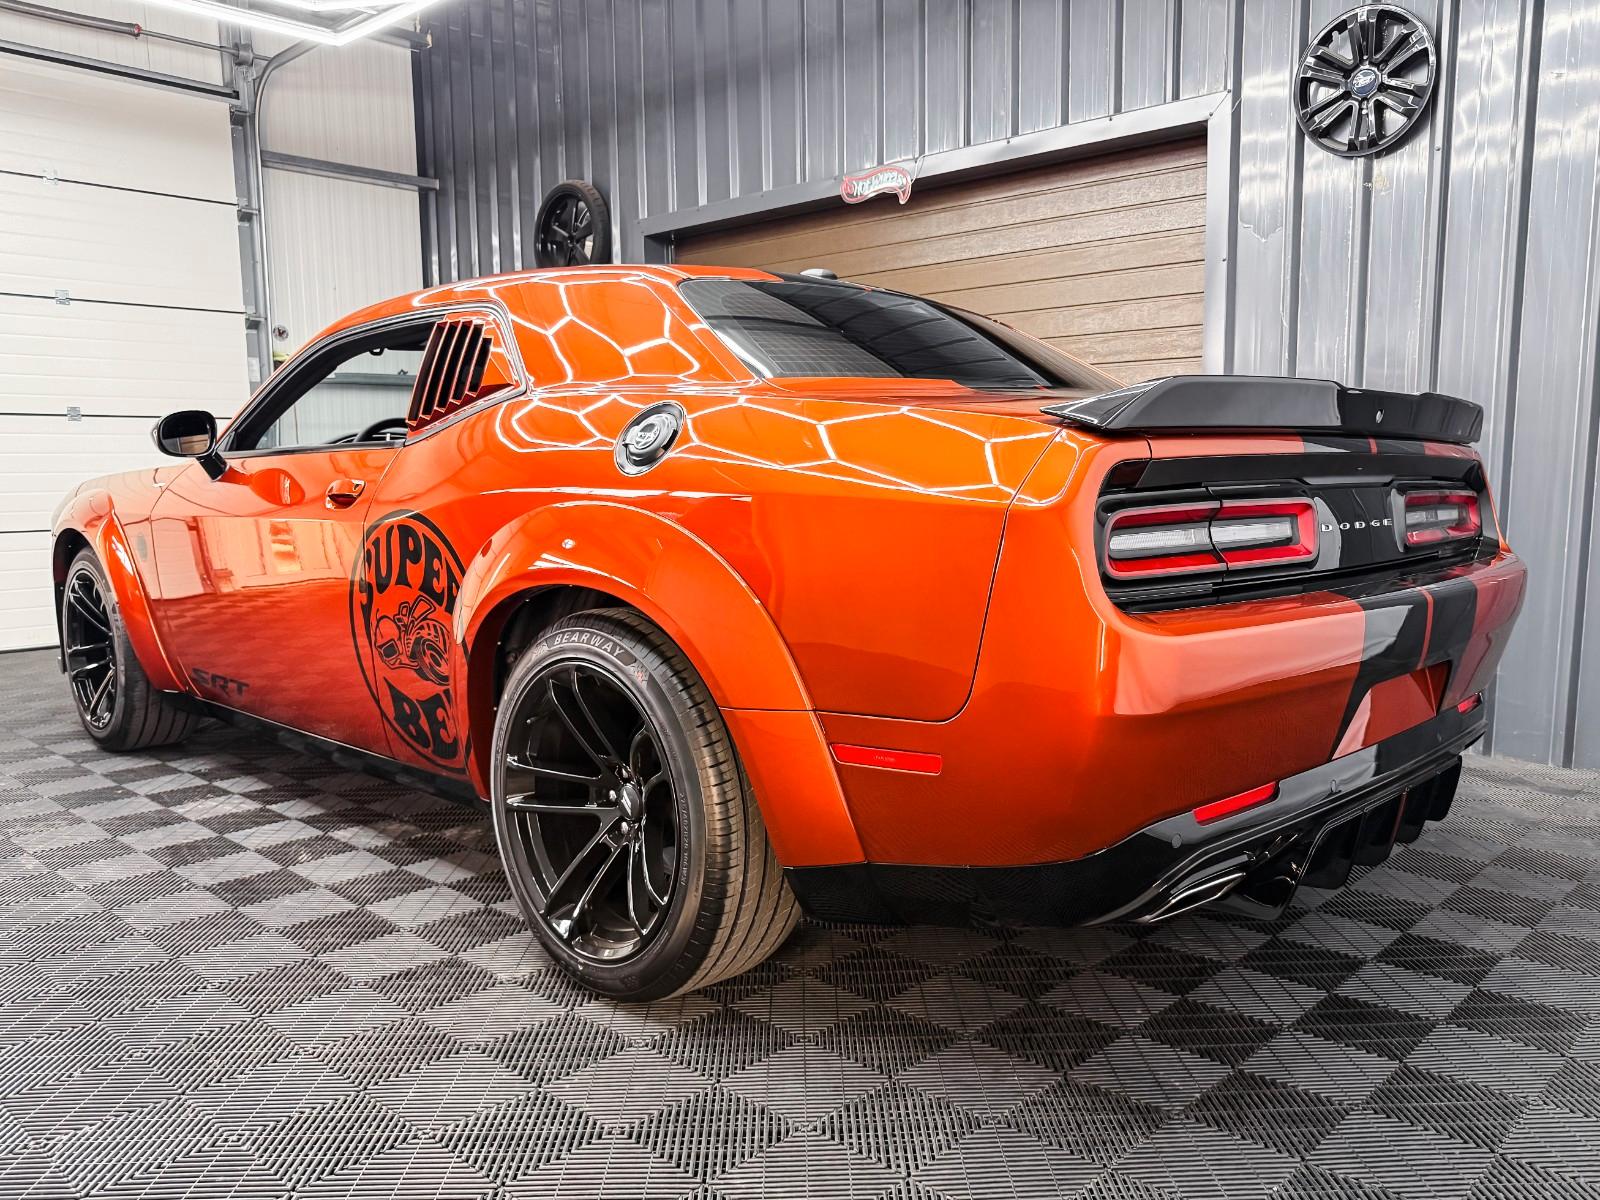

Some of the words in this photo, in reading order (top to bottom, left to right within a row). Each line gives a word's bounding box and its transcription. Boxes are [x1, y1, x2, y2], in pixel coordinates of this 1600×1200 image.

[1321, 518, 1392, 532] DODGE
[554, 631, 624, 656] BEARWAY
[191, 667, 250, 696] SRT
[384, 677, 458, 759] BE
